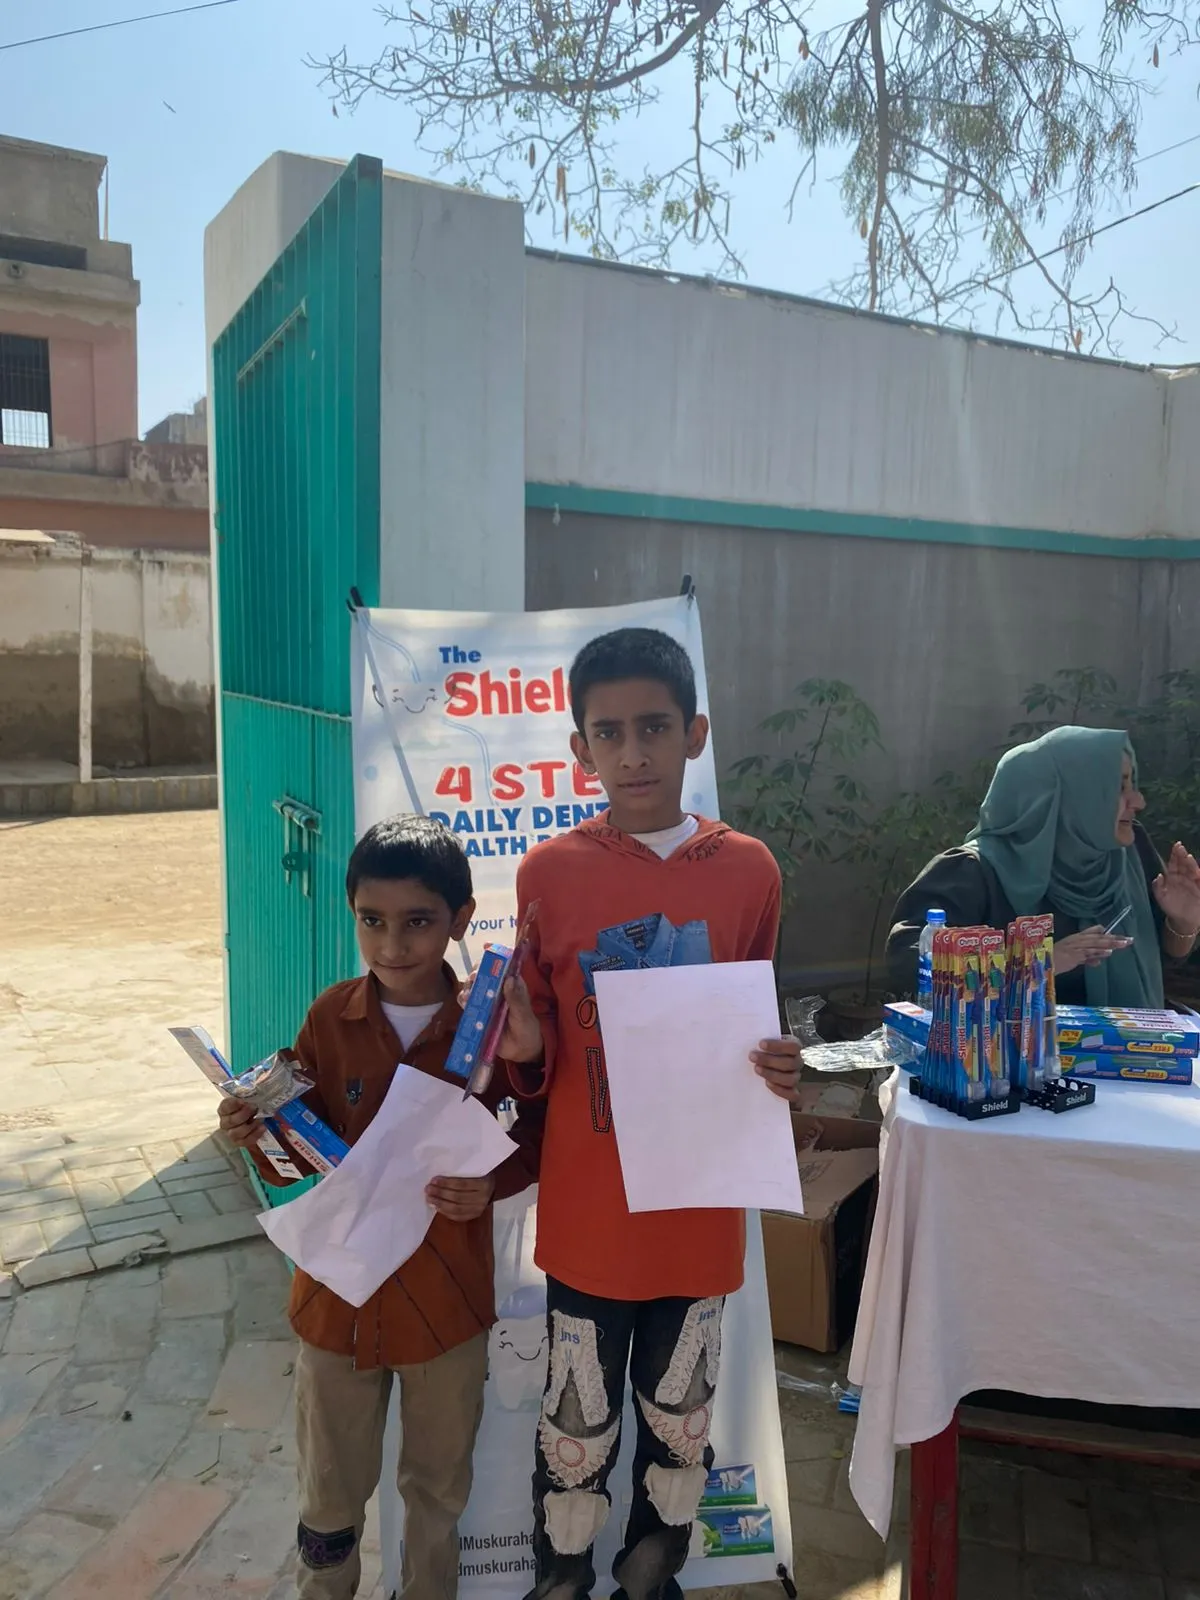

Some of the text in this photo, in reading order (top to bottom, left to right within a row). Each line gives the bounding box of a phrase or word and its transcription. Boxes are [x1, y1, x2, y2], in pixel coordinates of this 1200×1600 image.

[439, 645, 482, 664] The
[444, 666, 572, 717] Shiel
[435, 765, 473, 803] 4
[429, 806, 522, 834] DAILY
[470, 914, 518, 936] your t
[958, 1028, 967, 1060] Shield
[982, 1101, 1008, 1112] Shield
[1066, 1093, 1087, 1106] Shield
[459, 1532, 534, 1551] Muskuraha
